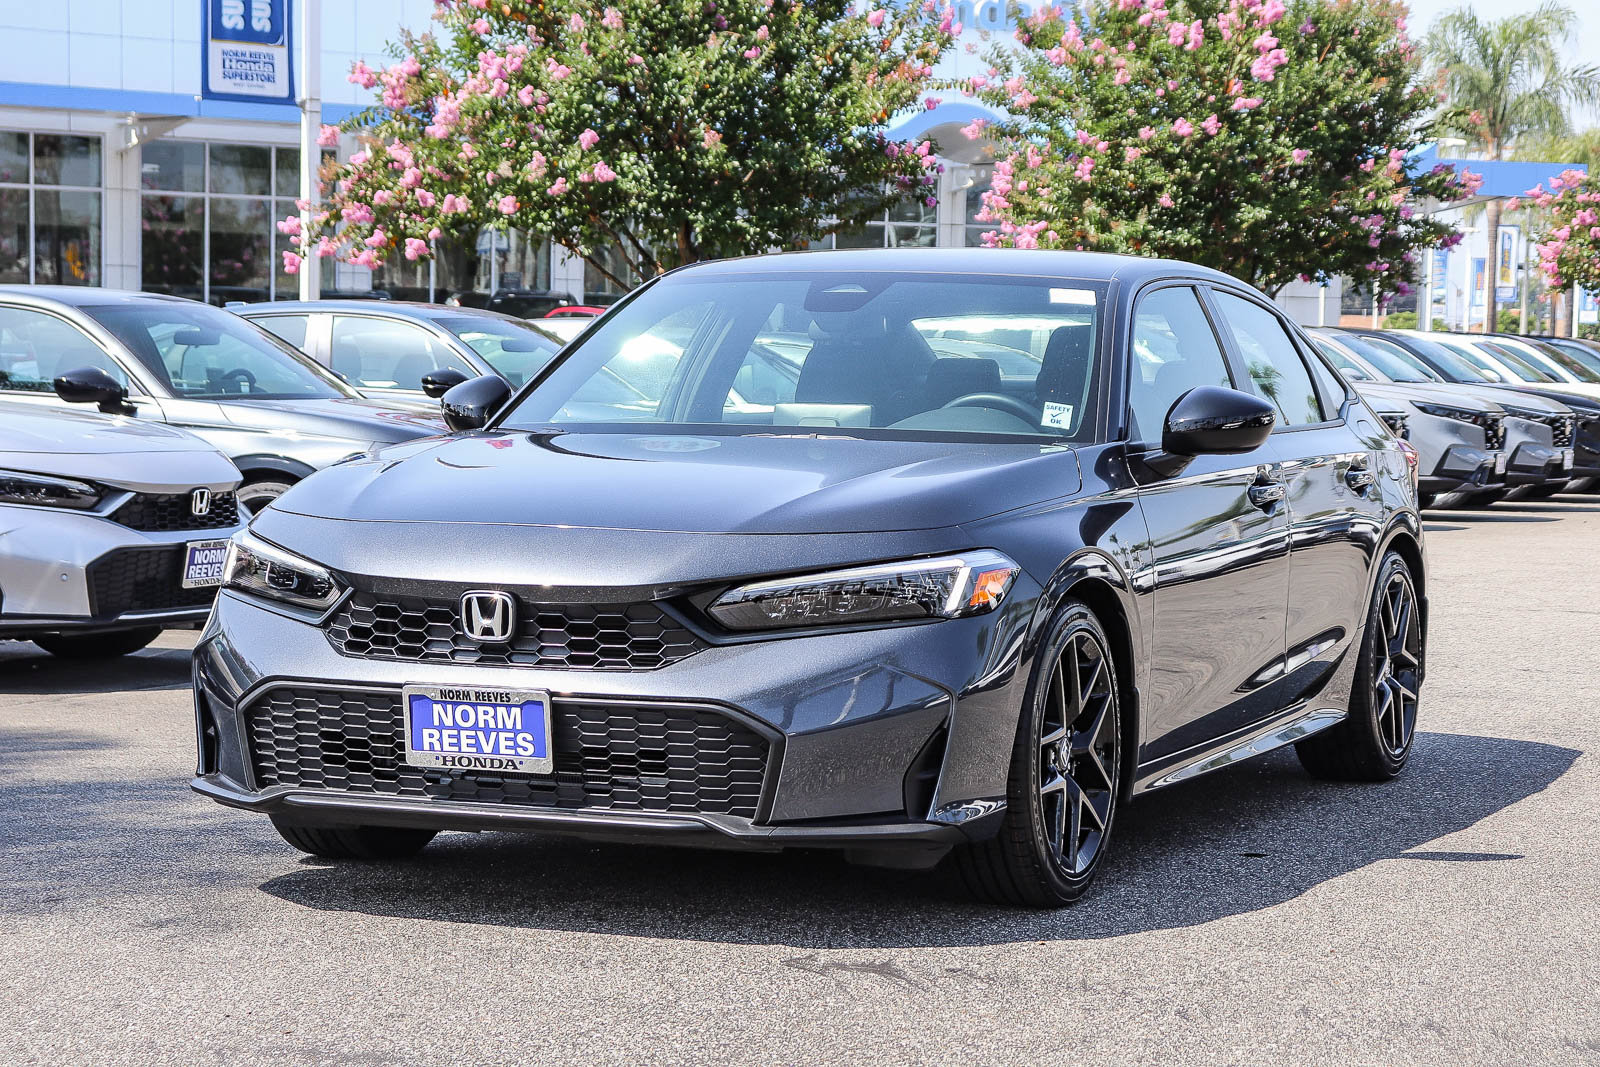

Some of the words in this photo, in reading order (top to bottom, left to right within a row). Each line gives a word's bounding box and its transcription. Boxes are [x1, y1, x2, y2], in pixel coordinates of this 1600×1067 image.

[223, 58, 274, 72] Honda
[223, 71, 275, 83] SUPERSTORE
[1046, 404, 1071, 412] SAFETY
[194, 549, 225, 564] NORM
[440, 688, 471, 701] NORM
[475, 690, 511, 703] REEVES
[432, 703, 523, 730] NORM
[422, 728, 535, 756] REEVES
[441, 755, 521, 770] HONDA
